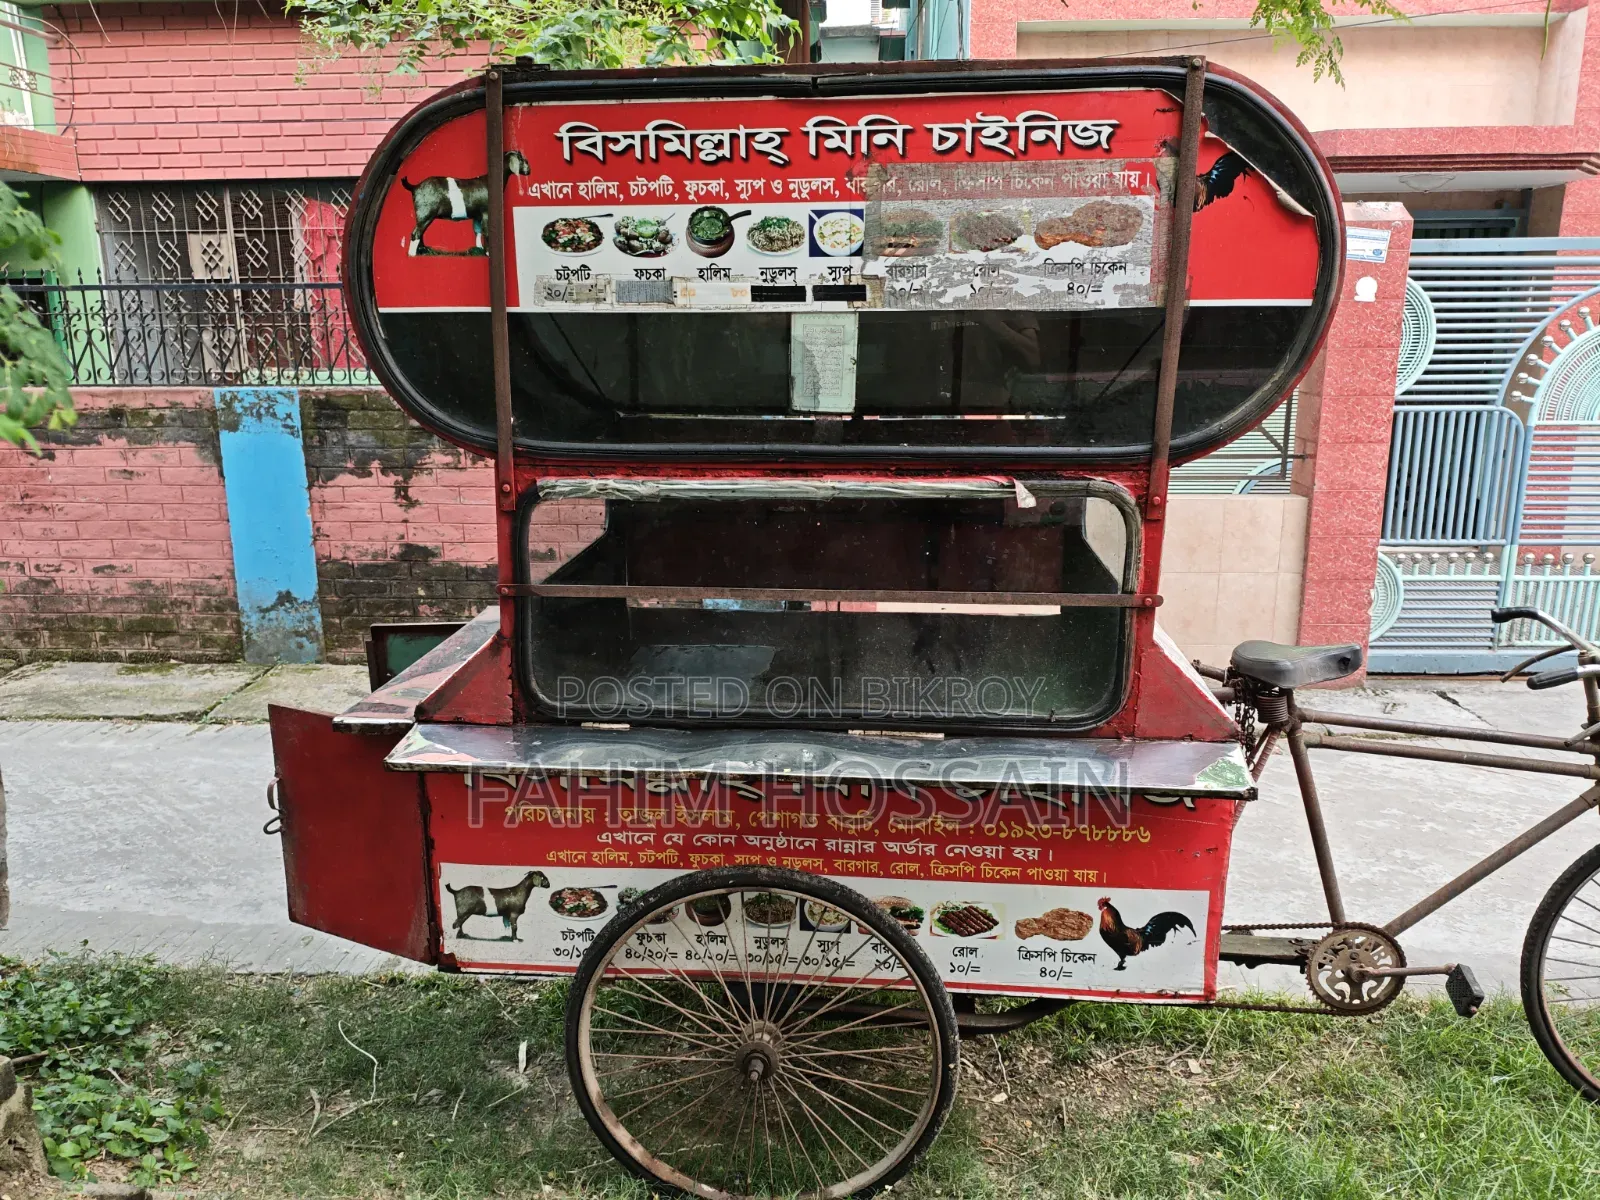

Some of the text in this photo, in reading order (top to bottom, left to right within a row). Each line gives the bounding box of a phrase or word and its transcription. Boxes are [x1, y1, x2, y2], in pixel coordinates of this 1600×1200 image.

[553, 110, 1120, 166] বিসমিল্লাহ্ মিনি চাইনিজ
[528, 180, 572, 200] এখানে
[577, 177, 624, 202] হালিম,
[628, 174, 679, 201] চটপটি,
[684, 178, 730, 202] ফুচকা,
[734, 177, 765, 200] স্যুপ
[771, 179, 784, 195] ও
[787, 177, 840, 200] নুডুলস,
[1112, 169, 1141, 190] যায়
[554, 264, 592, 282] চটপটি
[696, 262, 732, 282] হালিম
[674, 803, 741, 831] ইসলাম,
[888, 811, 962, 838] মোবাইল
[596, 830, 657, 846] এখানে
[663, 832, 686, 846] যে
[692, 832, 738, 848] কোন
[742, 831, 818, 852] অনুষ্ঠানে
[823, 837, 877, 855] রান্নার
[882, 838, 938, 857] অর্ডার
[945, 843, 1003, 860] নেওয়া
[1011, 846, 1042, 863] হয়
[546, 848, 587, 863] এখানে
[592, 847, 633, 866] হালিম,
[638, 848, 684, 867] চটপটি,
[688, 853, 729, 869] ফুচকা,
[766, 855, 777, 866] ও
[833, 858, 884, 876] বারগার,
[889, 861, 925, 879] রোল,
[929, 860, 976, 879] ক্রিসপি
[980, 862, 1022, 880] চিকেন
[1026, 866, 1069, 882] পাওয়া
[1073, 868, 1099, 884] যায়
[560, 927, 595, 942] চটপটি
[952, 945, 978, 959] রোল
[1017, 945, 1096, 965] ক্রিসপি চিকেন
[949, 961, 981, 976] ১০/=
[1039, 966, 1073, 981] ৪০/=
